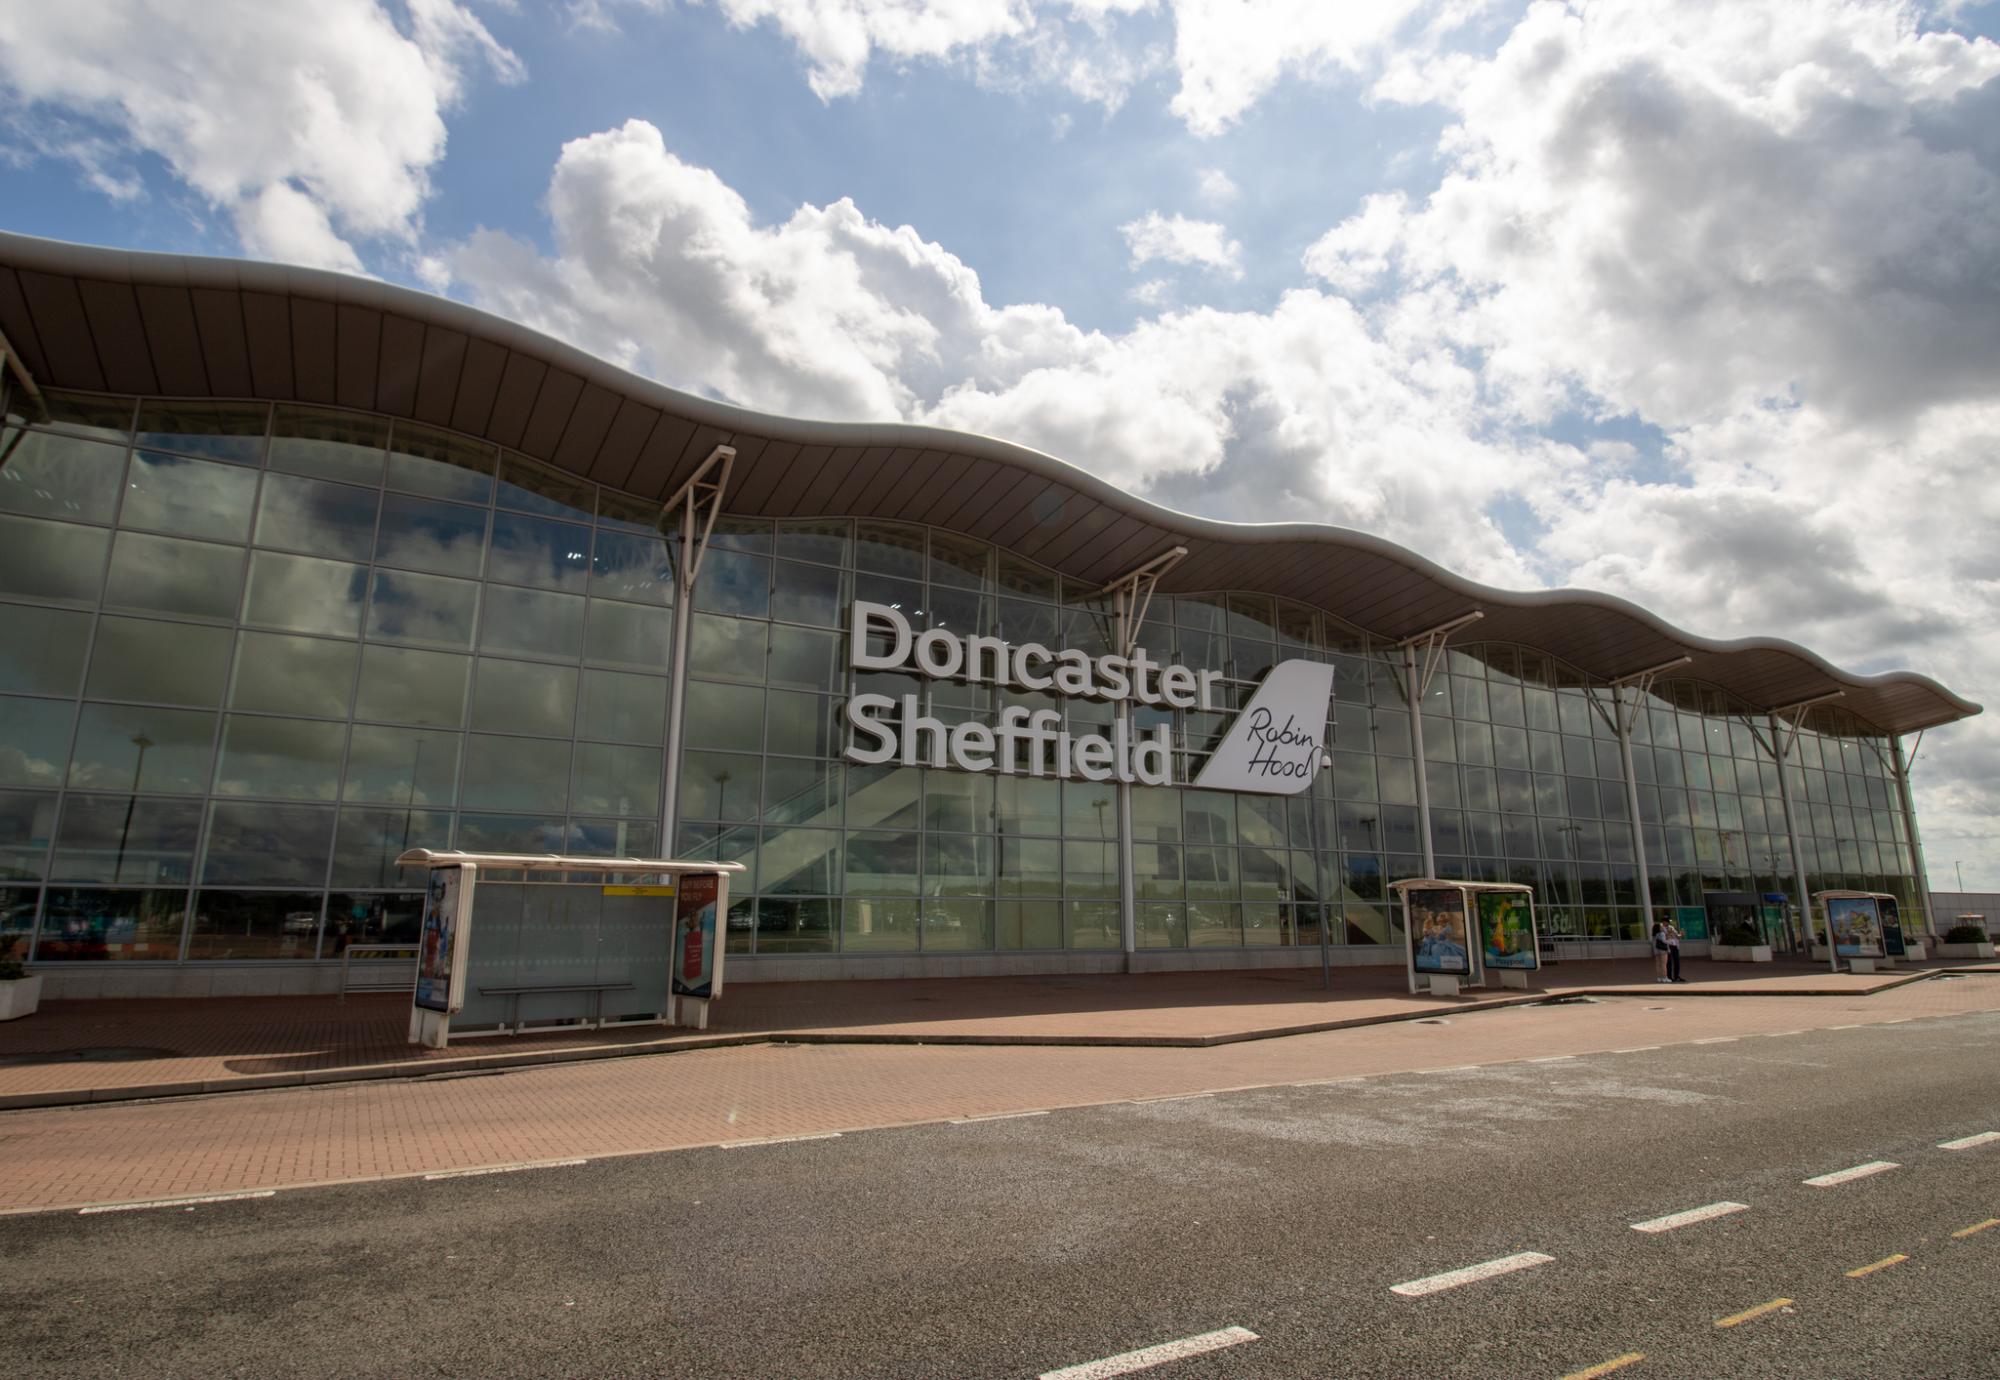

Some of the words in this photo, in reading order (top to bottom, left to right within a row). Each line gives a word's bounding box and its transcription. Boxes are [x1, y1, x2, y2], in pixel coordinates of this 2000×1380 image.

[852, 600, 1223, 710] Doncaster
[847, 693, 1171, 786] Sheffield
[1247, 707, 1313, 747] Robin
[1248, 745, 1313, 778] Hood
